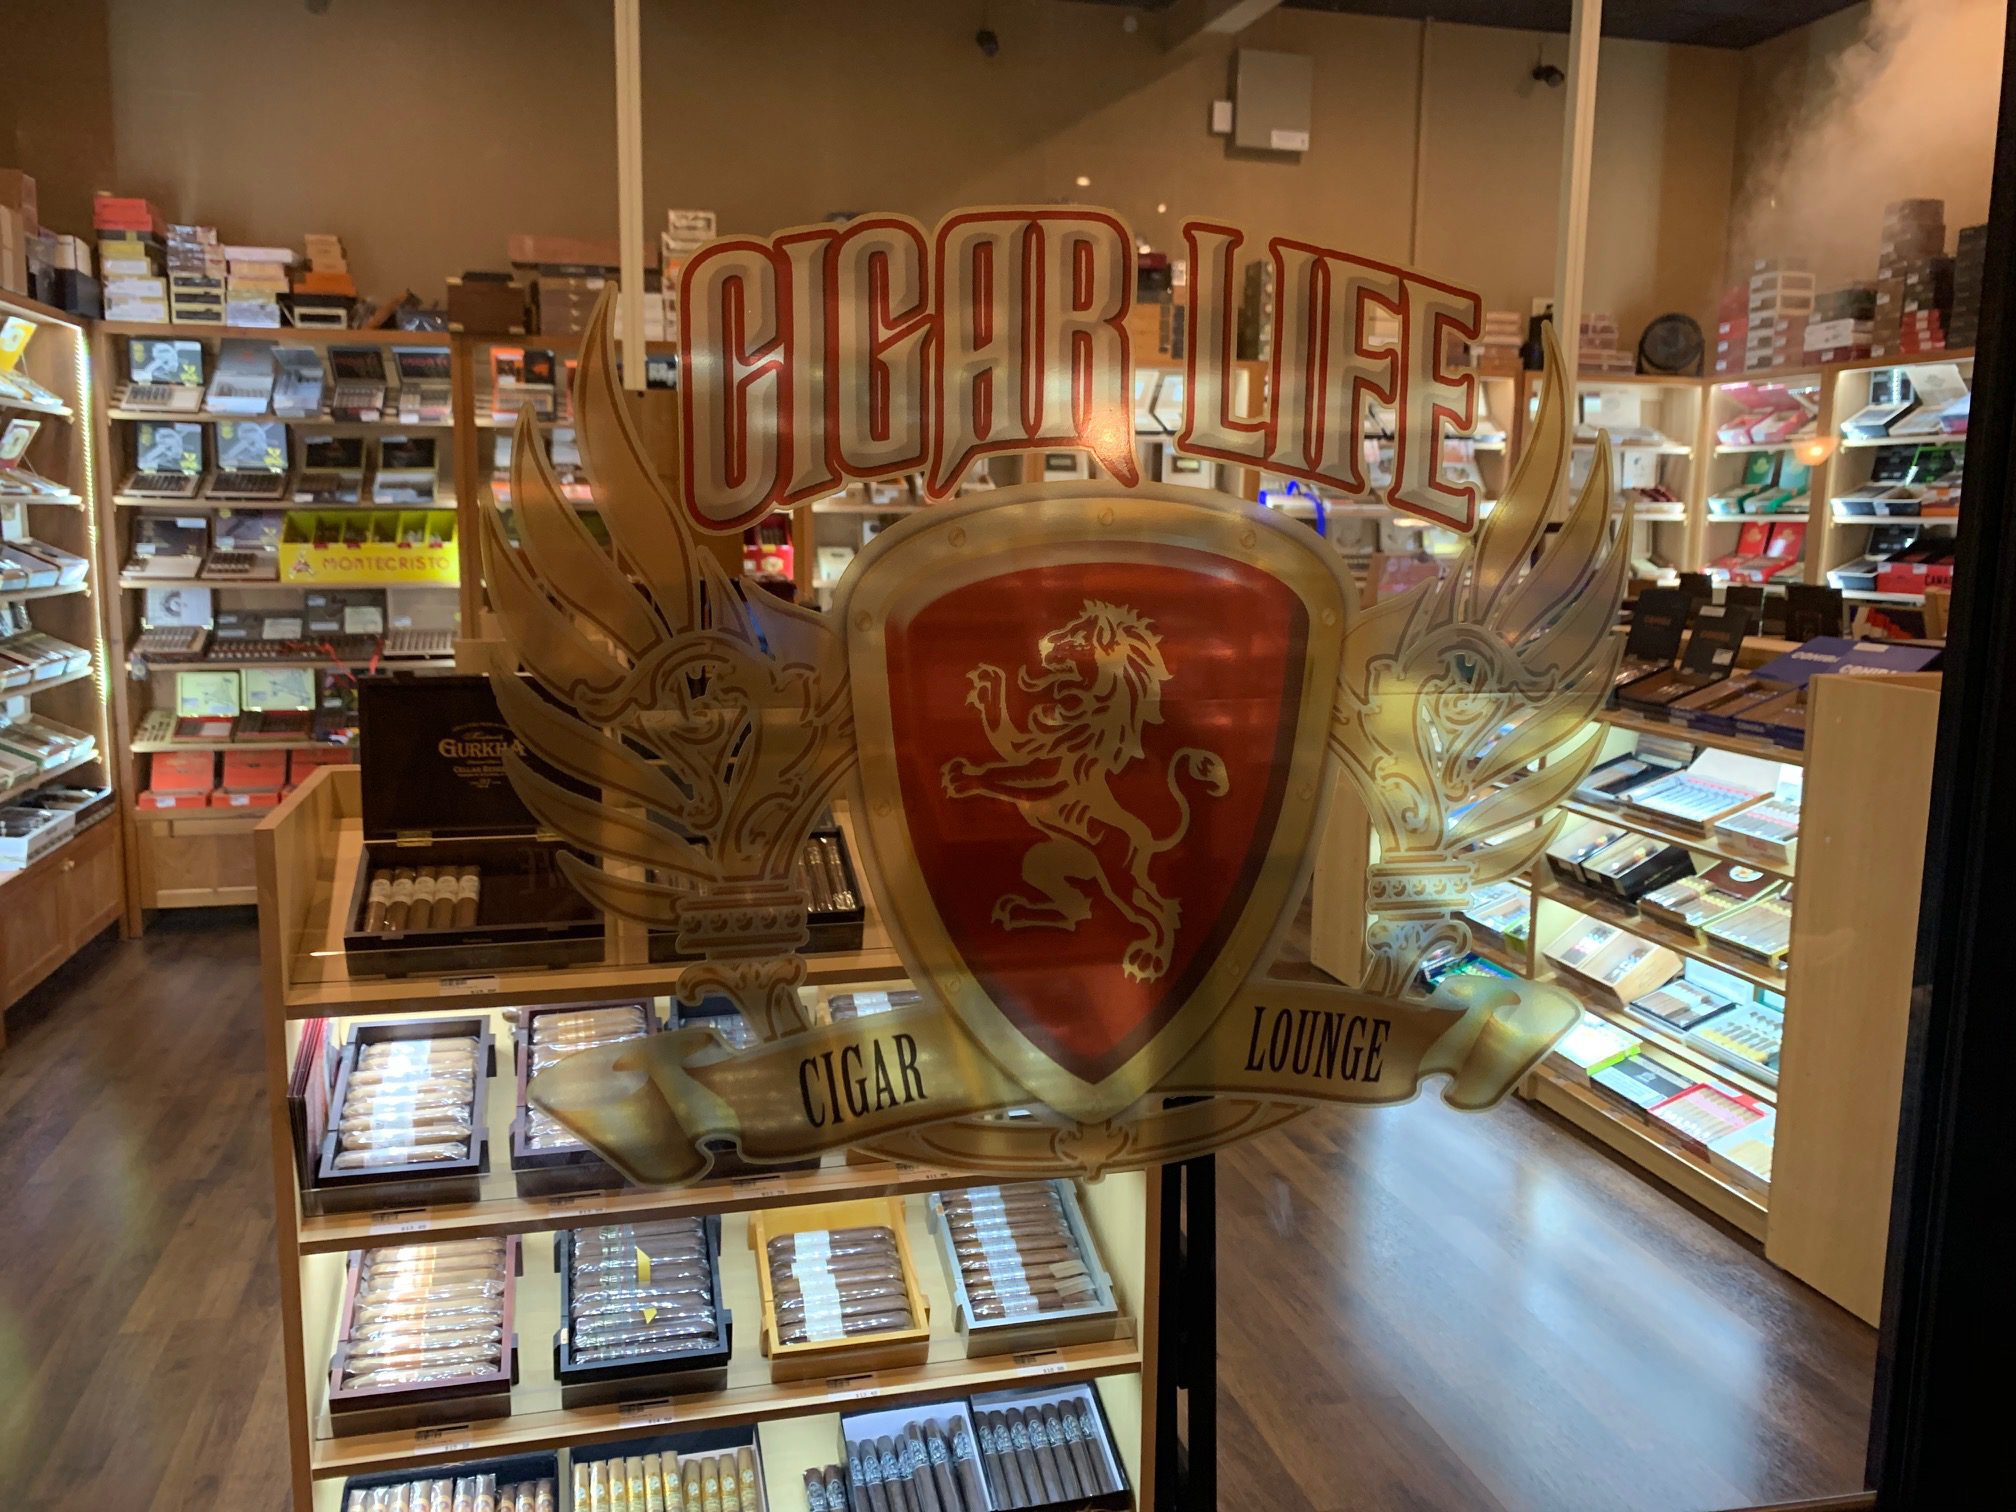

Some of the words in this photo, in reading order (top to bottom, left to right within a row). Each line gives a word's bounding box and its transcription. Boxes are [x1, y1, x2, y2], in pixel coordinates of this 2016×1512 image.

[678, 207, 1140, 532] CIGAR
[1176, 220, 1484, 535] LIFE
[321, 555, 451, 572] MONTECRISTO
[798, 1033, 928, 1128] CIGAR
[1244, 1006, 1391, 1083] LOUNGE
